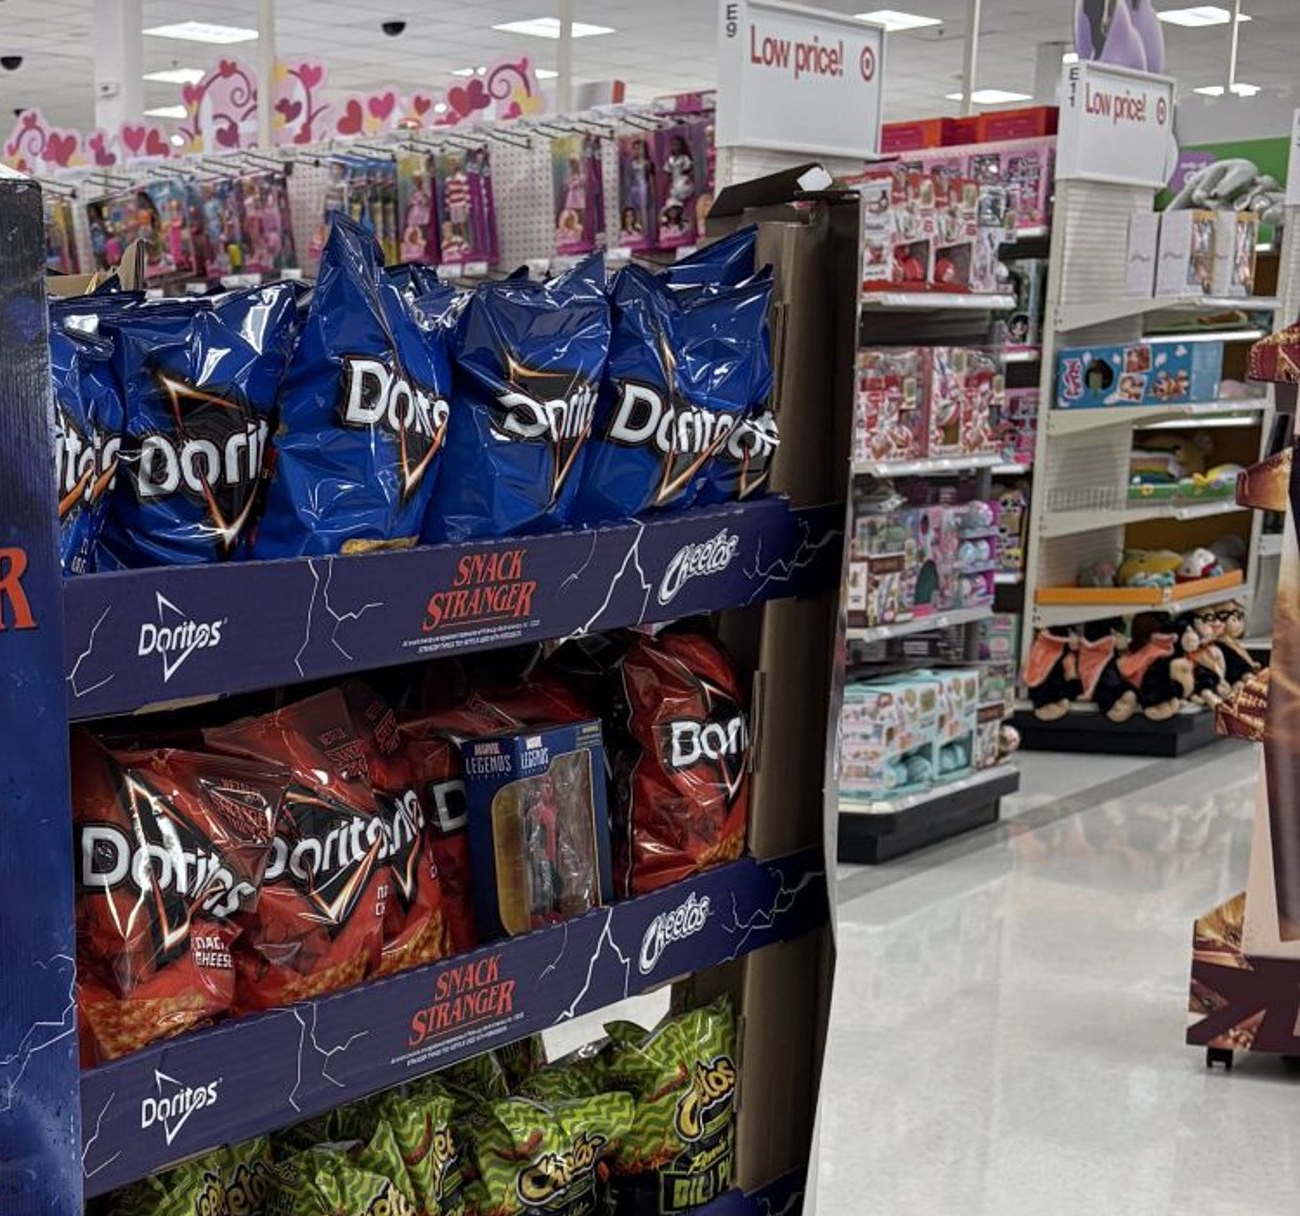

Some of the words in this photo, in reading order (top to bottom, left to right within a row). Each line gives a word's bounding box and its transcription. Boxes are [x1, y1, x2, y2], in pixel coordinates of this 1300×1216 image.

[750, 25, 791, 68] Low
[794, 35, 843, 79] price!
[1086, 83, 1110, 114] Low
[1113, 89, 1147, 123] price!
[611, 384, 738, 456] Dorito
[453, 549, 528, 587] SNACK
[657, 528, 740, 606] Cheetos
[422, 581, 538, 632] STRANGER
[138, 620, 222, 657] Doritos
[465, 754, 512, 775] LEGENDS
[639, 891, 711, 975] Cheetos
[433, 954, 503, 1001] SNACK
[408, 979, 516, 1047] STRANGER
[141, 1080, 218, 1129] Doritos
